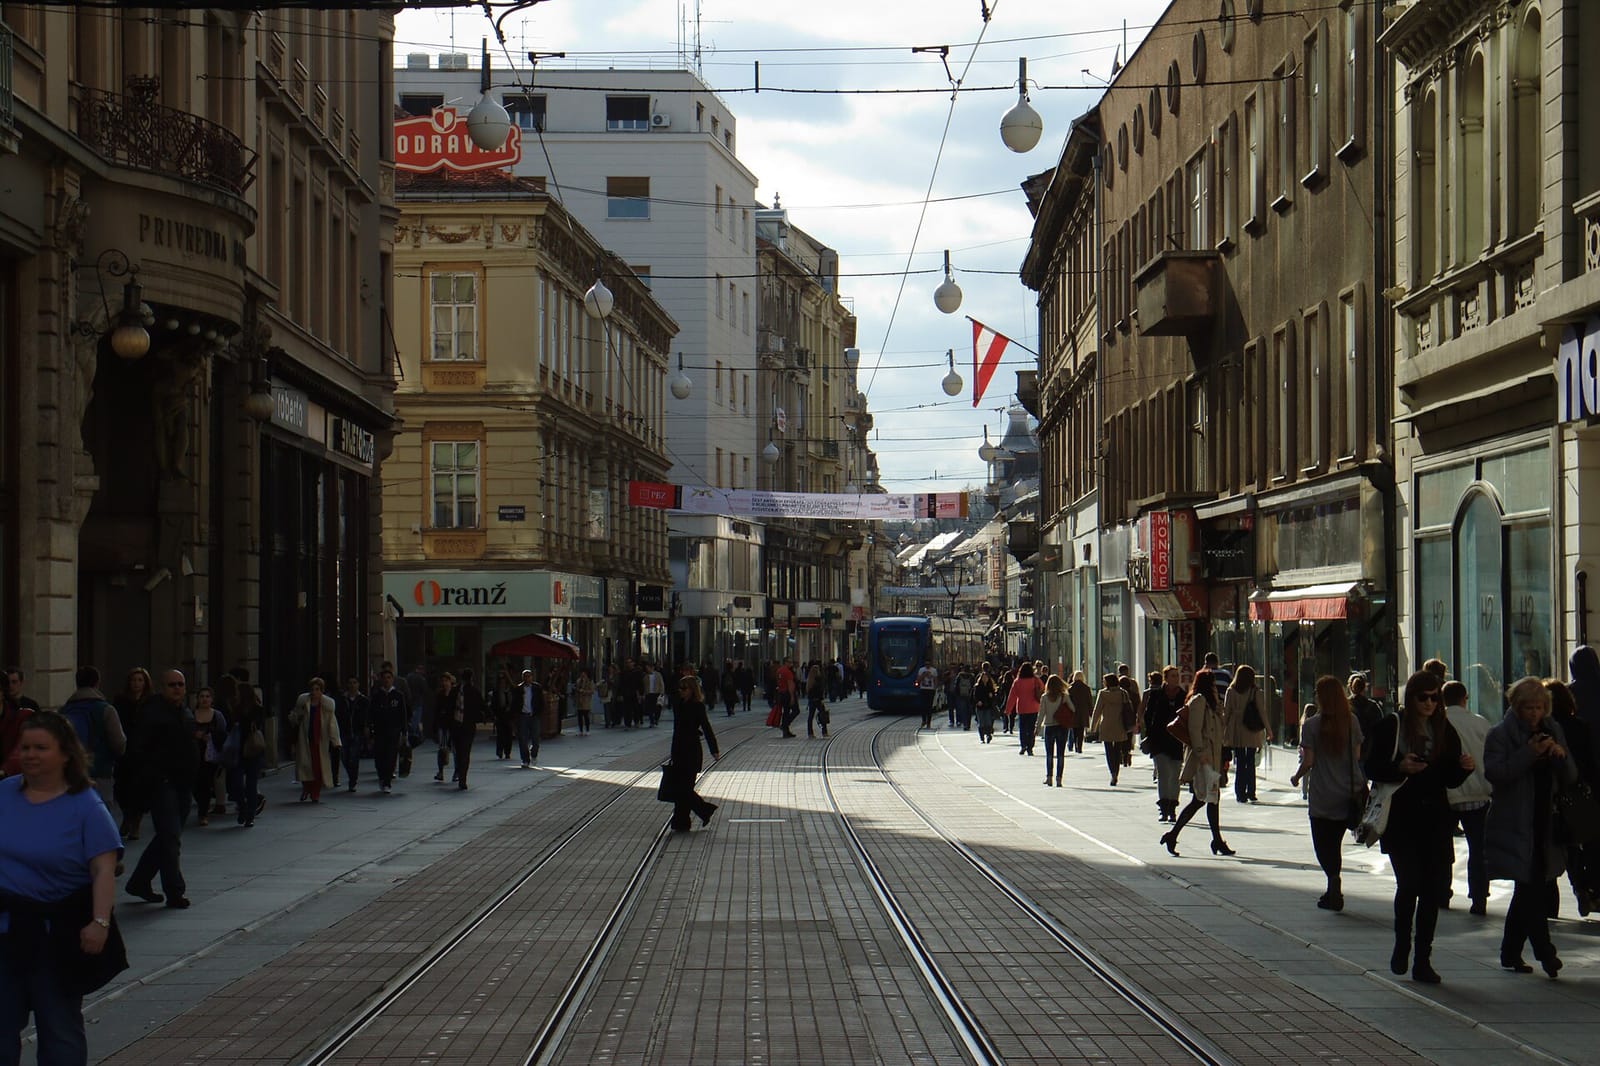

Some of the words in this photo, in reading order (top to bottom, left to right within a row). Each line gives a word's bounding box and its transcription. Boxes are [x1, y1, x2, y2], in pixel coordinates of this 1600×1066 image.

[397, 134, 506, 154] ODRAV
[139, 213, 227, 263] PRIVREDNA
[276, 390, 304, 428] roberto
[1157, 513, 1168, 588] MONROE
[413, 580, 506, 606] Oranž
